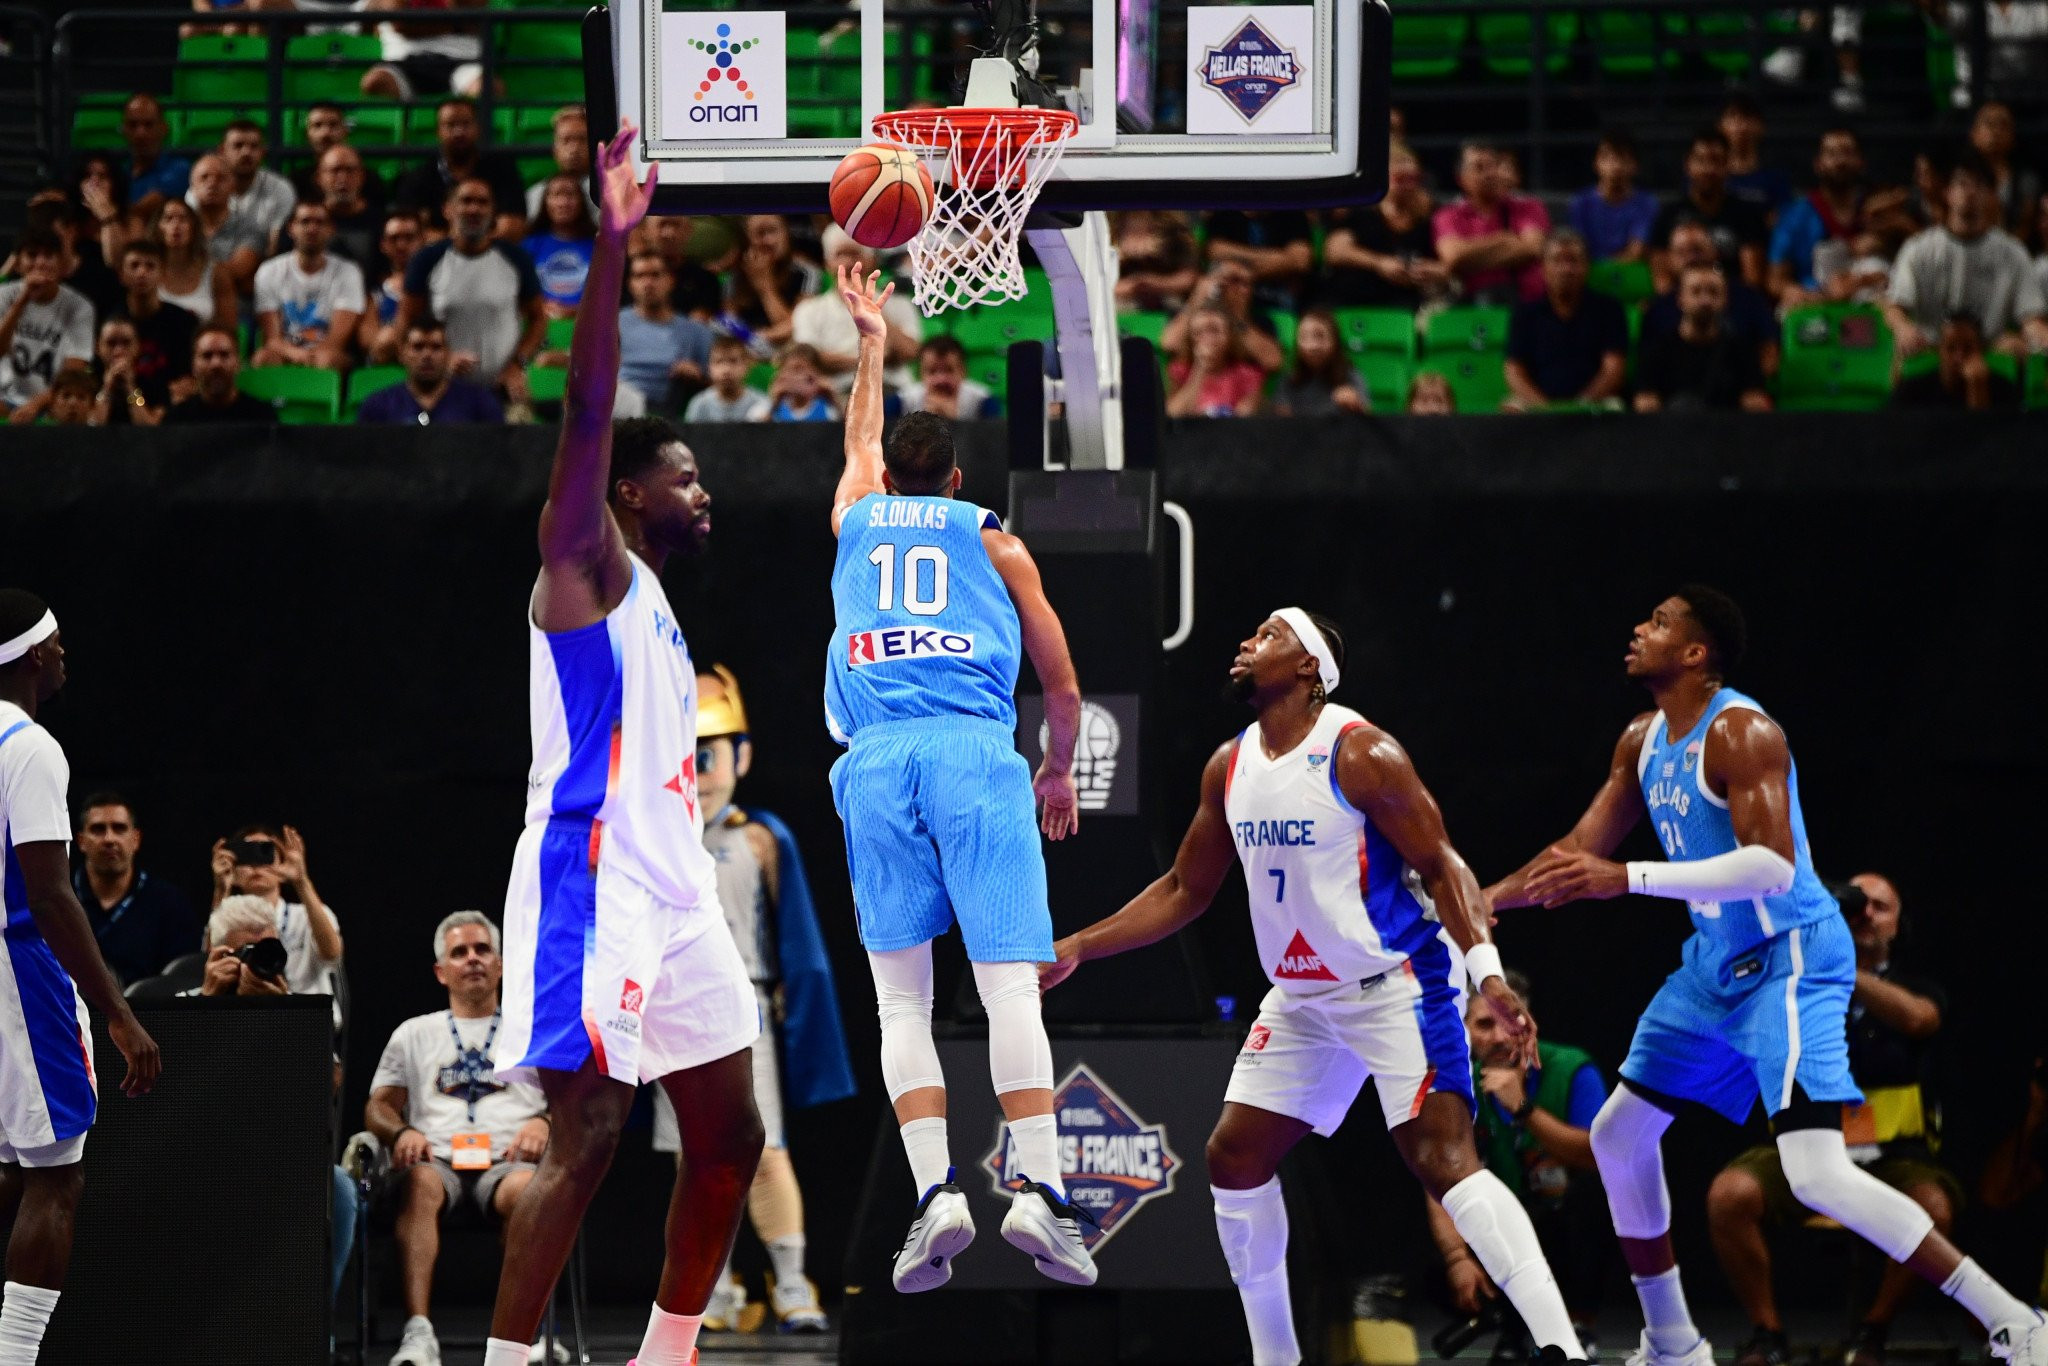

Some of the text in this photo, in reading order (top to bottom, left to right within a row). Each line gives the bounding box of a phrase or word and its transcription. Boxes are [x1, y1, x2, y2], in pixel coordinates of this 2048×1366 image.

[1209, 54, 1293, 80] HELLAS FRANCE
[868, 501, 949, 530] SLOUKAS
[868, 543, 949, 616] 10
[882, 630, 971, 657] EKO
[1236, 820, 1316, 847] FRANCE
[1268, 868, 1285, 903] 7
[1281, 955, 1322, 973] MAIF
[1081, 1134, 1163, 1181] FRANCE
